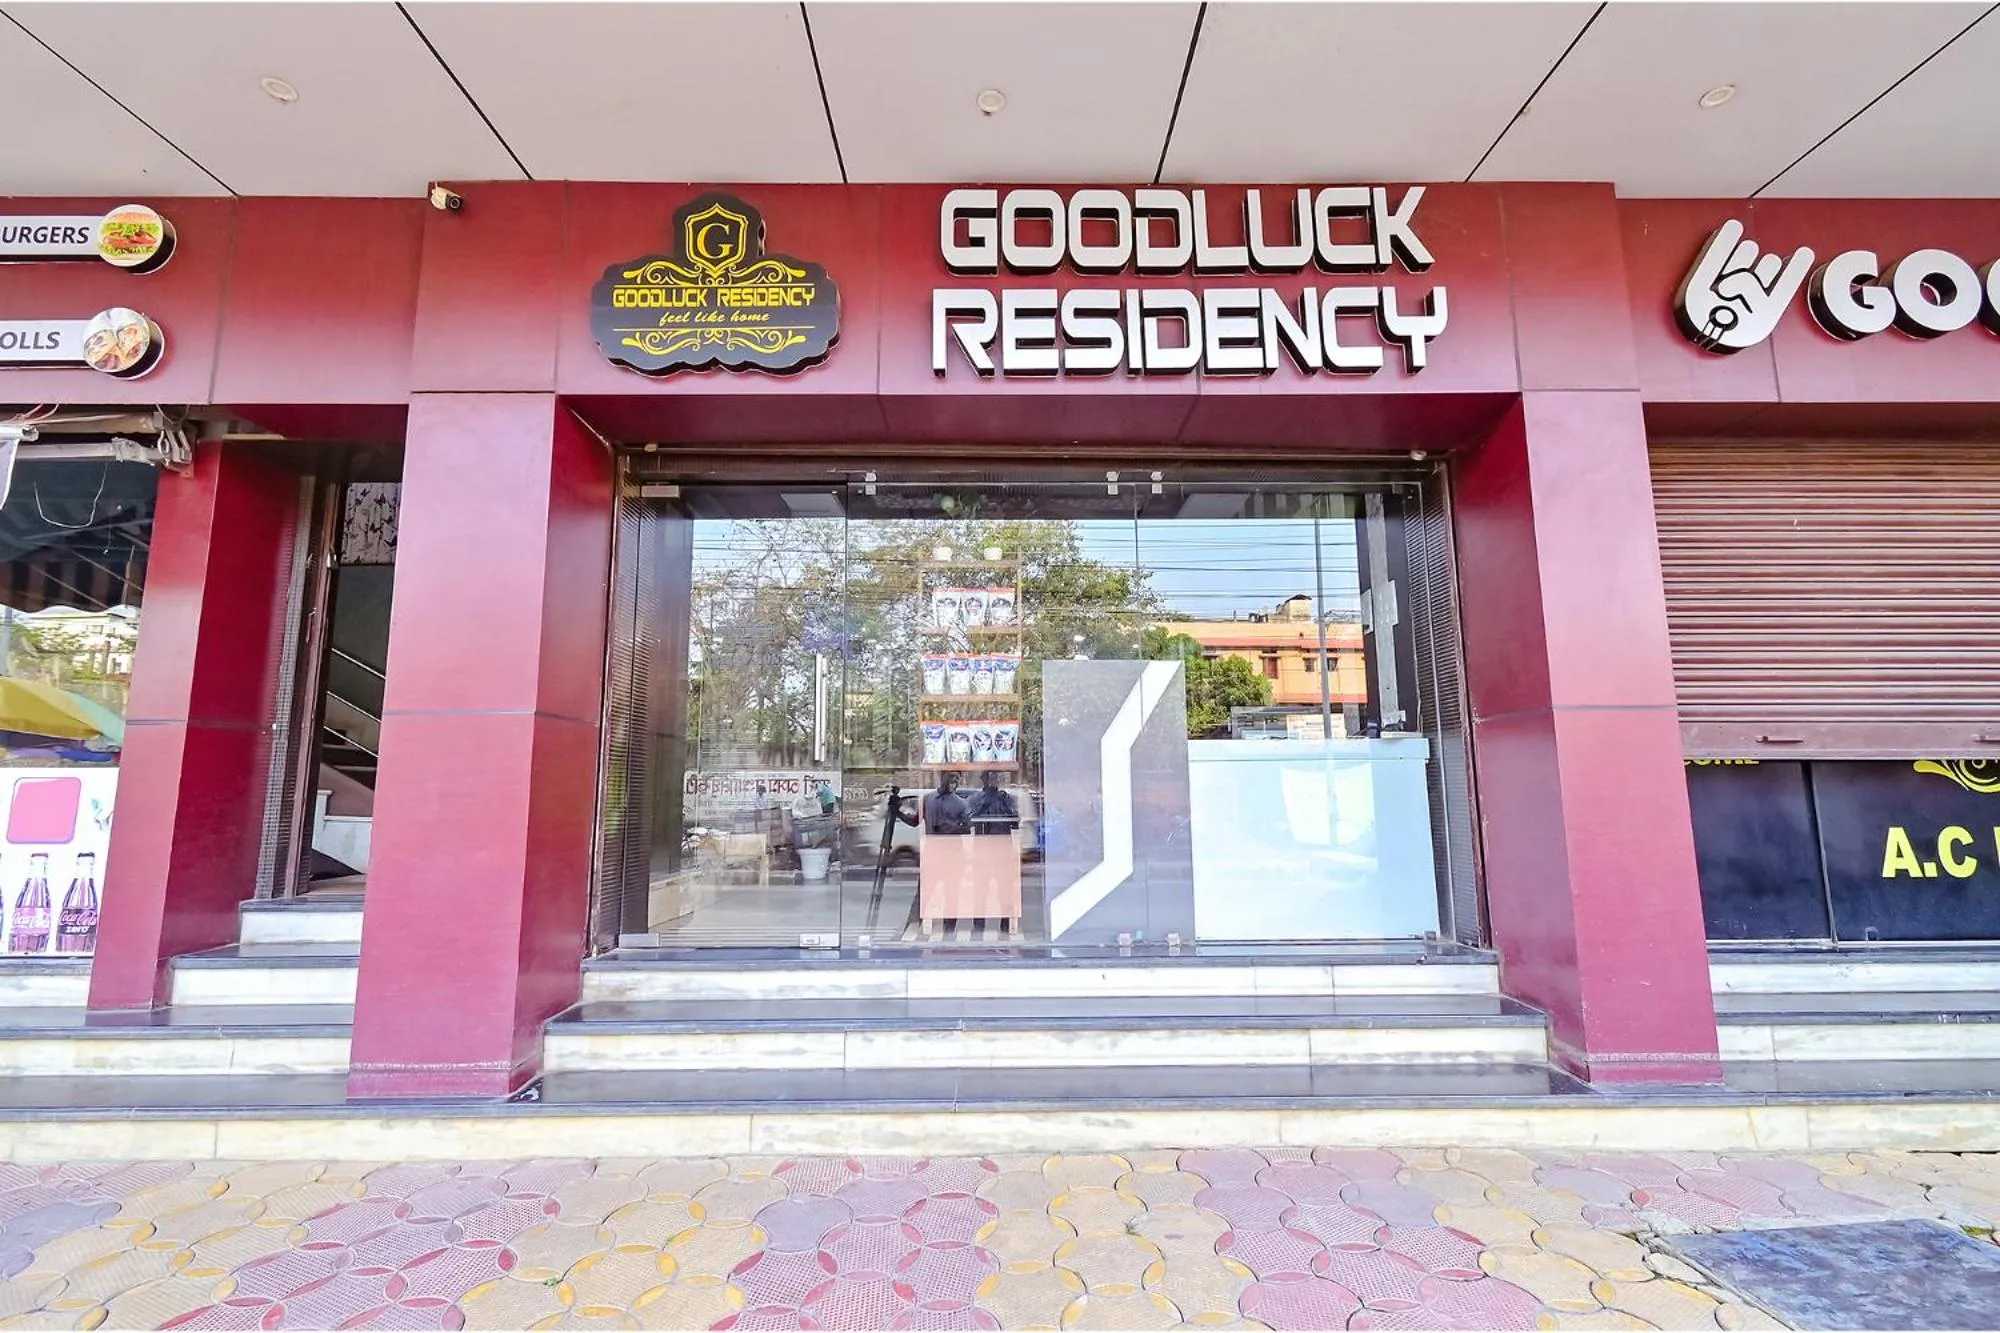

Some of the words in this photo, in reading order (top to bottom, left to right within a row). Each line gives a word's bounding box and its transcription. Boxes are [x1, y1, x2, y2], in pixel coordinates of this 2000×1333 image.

[0, 226, 89, 244] URGERS
[696, 223, 733, 259] G
[941, 186, 1435, 268] GOODLUCK
[612, 288, 707, 308] GOODLUCK
[717, 287, 815, 308] RESIDENCY
[1823, 248, 2000, 334] GO
[658, 310, 690, 327] feel
[694, 310, 725, 323] like
[730, 310, 770, 323] home
[932, 286, 1449, 371] RESIDENCY
